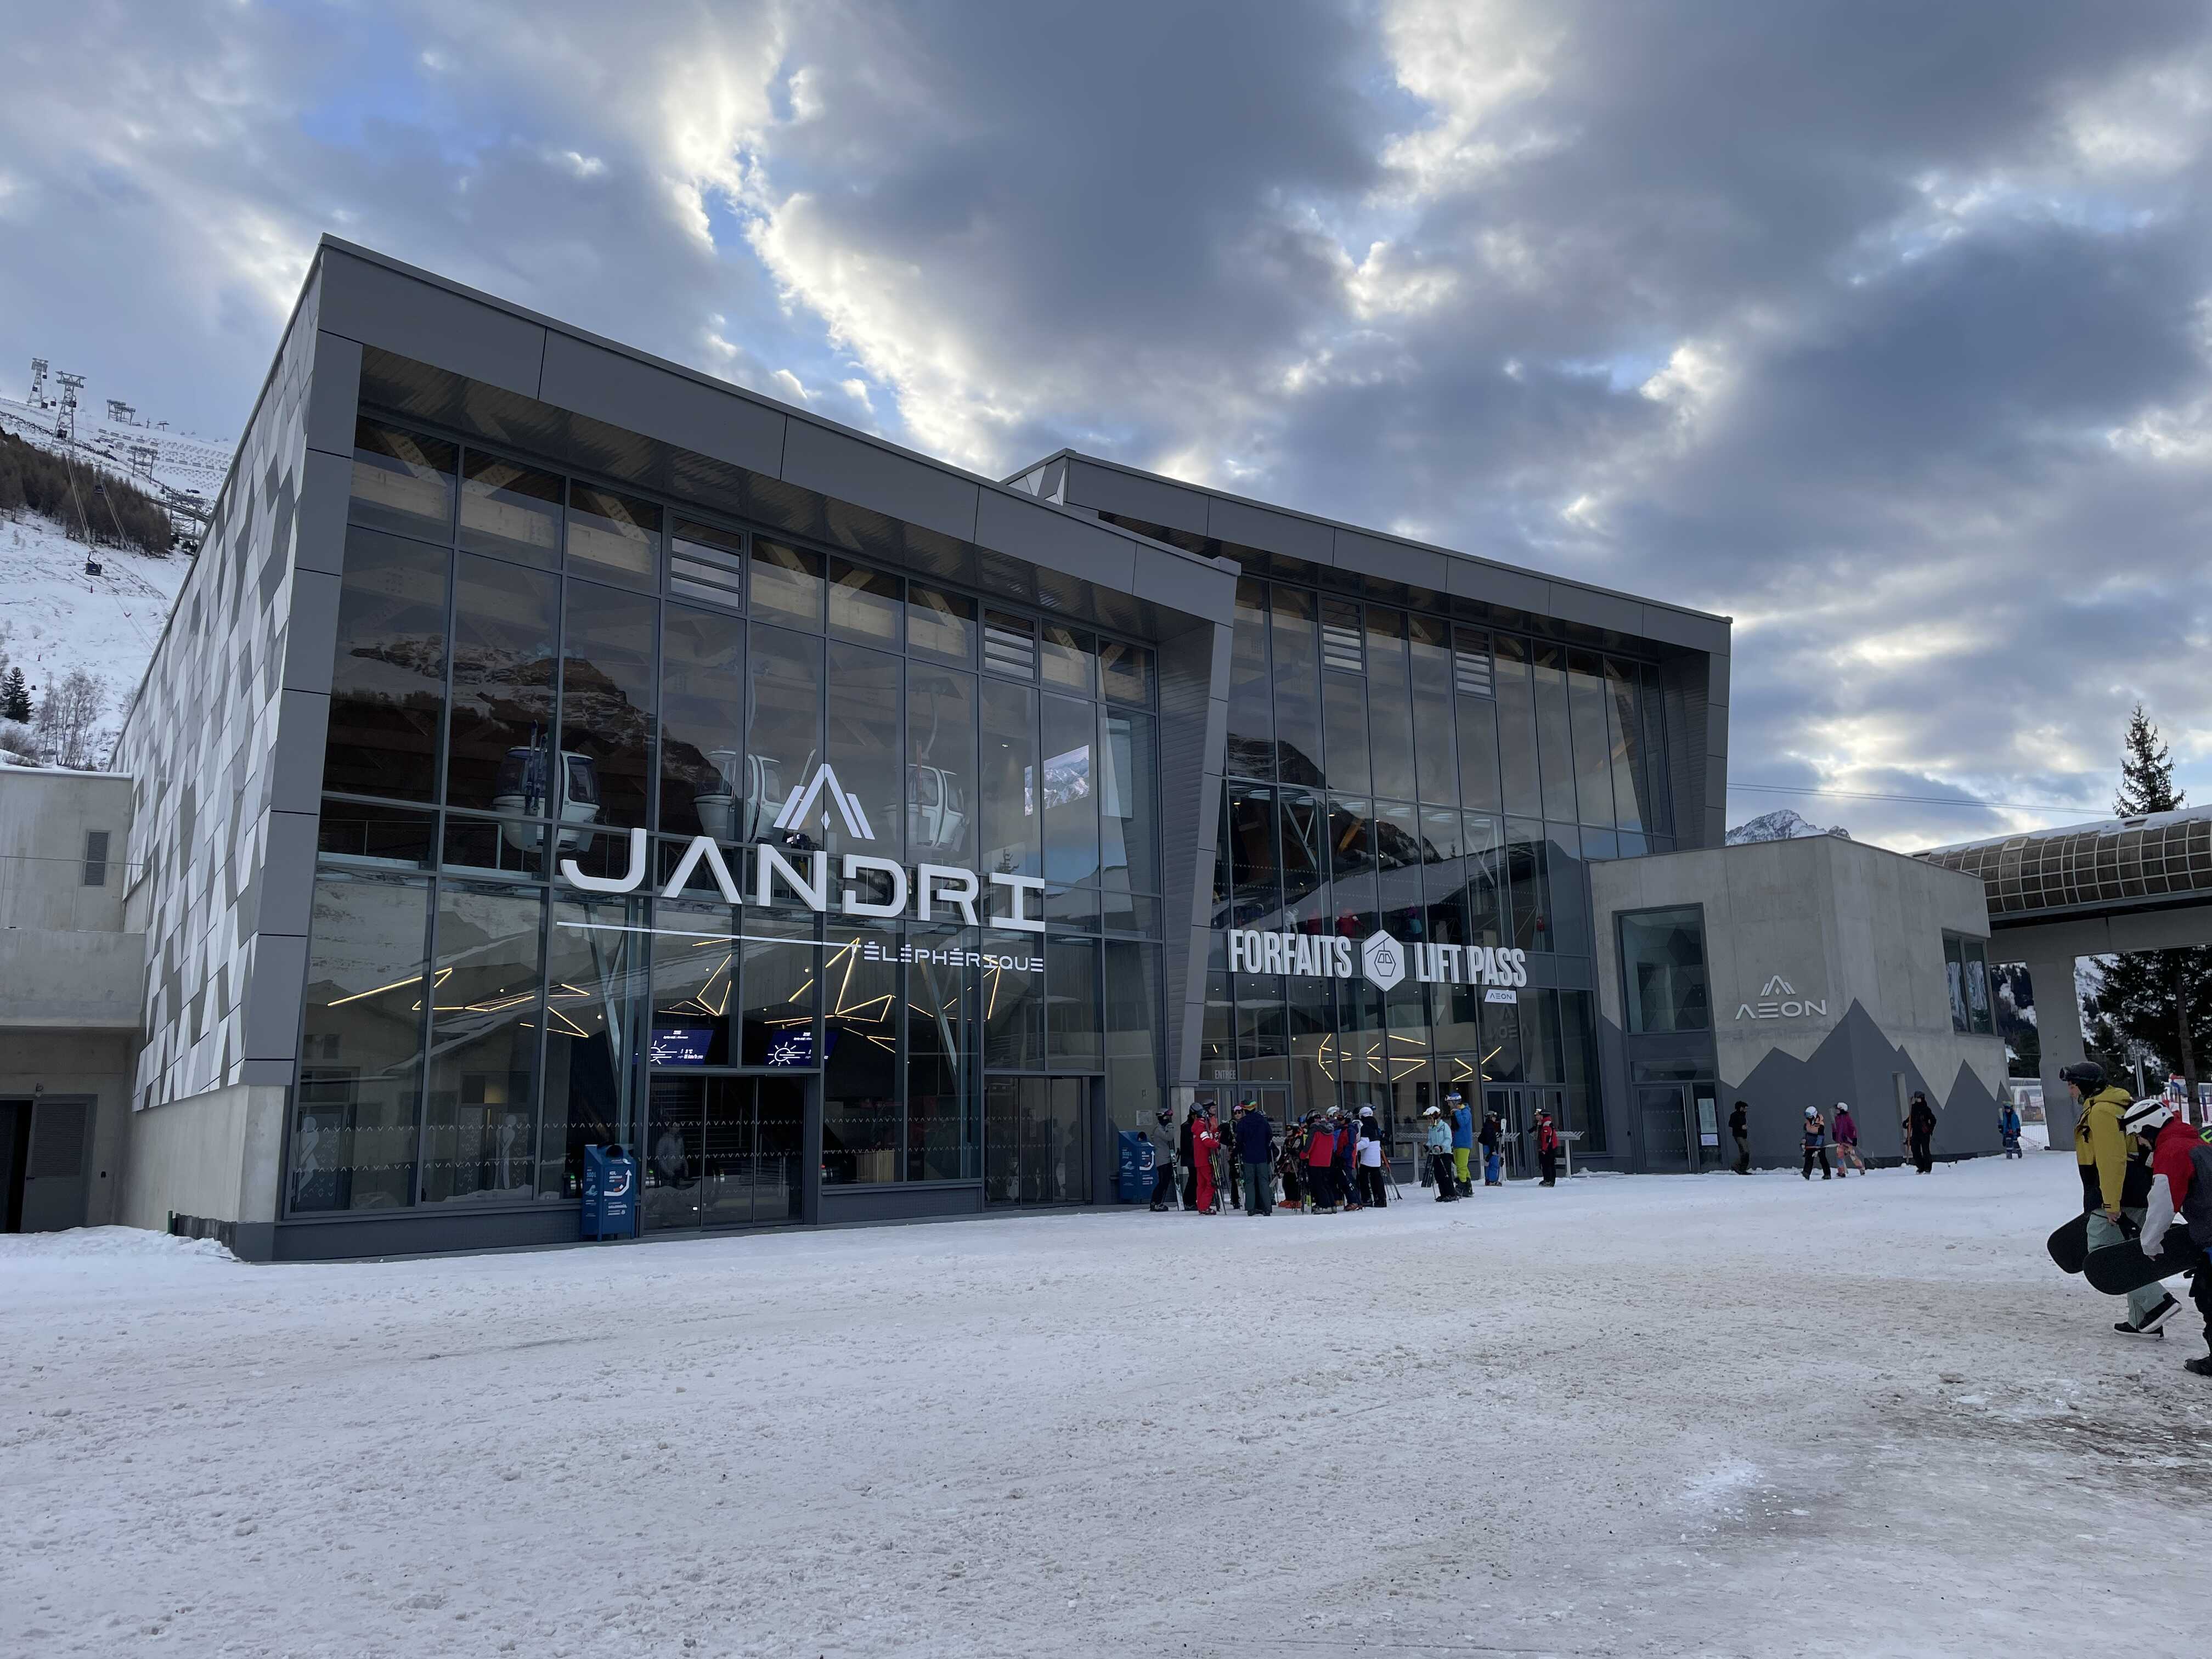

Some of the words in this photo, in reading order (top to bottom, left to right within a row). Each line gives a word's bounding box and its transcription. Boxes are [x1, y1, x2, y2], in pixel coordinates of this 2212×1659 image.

[560, 827, 1046, 933] JANDRI
[845, 940, 1044, 973] TÉLÉPHÉRIQUE
[1228, 929, 1353, 979] FORFAITS
[1414, 941, 1462, 984] LIFT
[1466, 945, 1527, 988] PASS
[1735, 999, 1827, 1020] AEON
